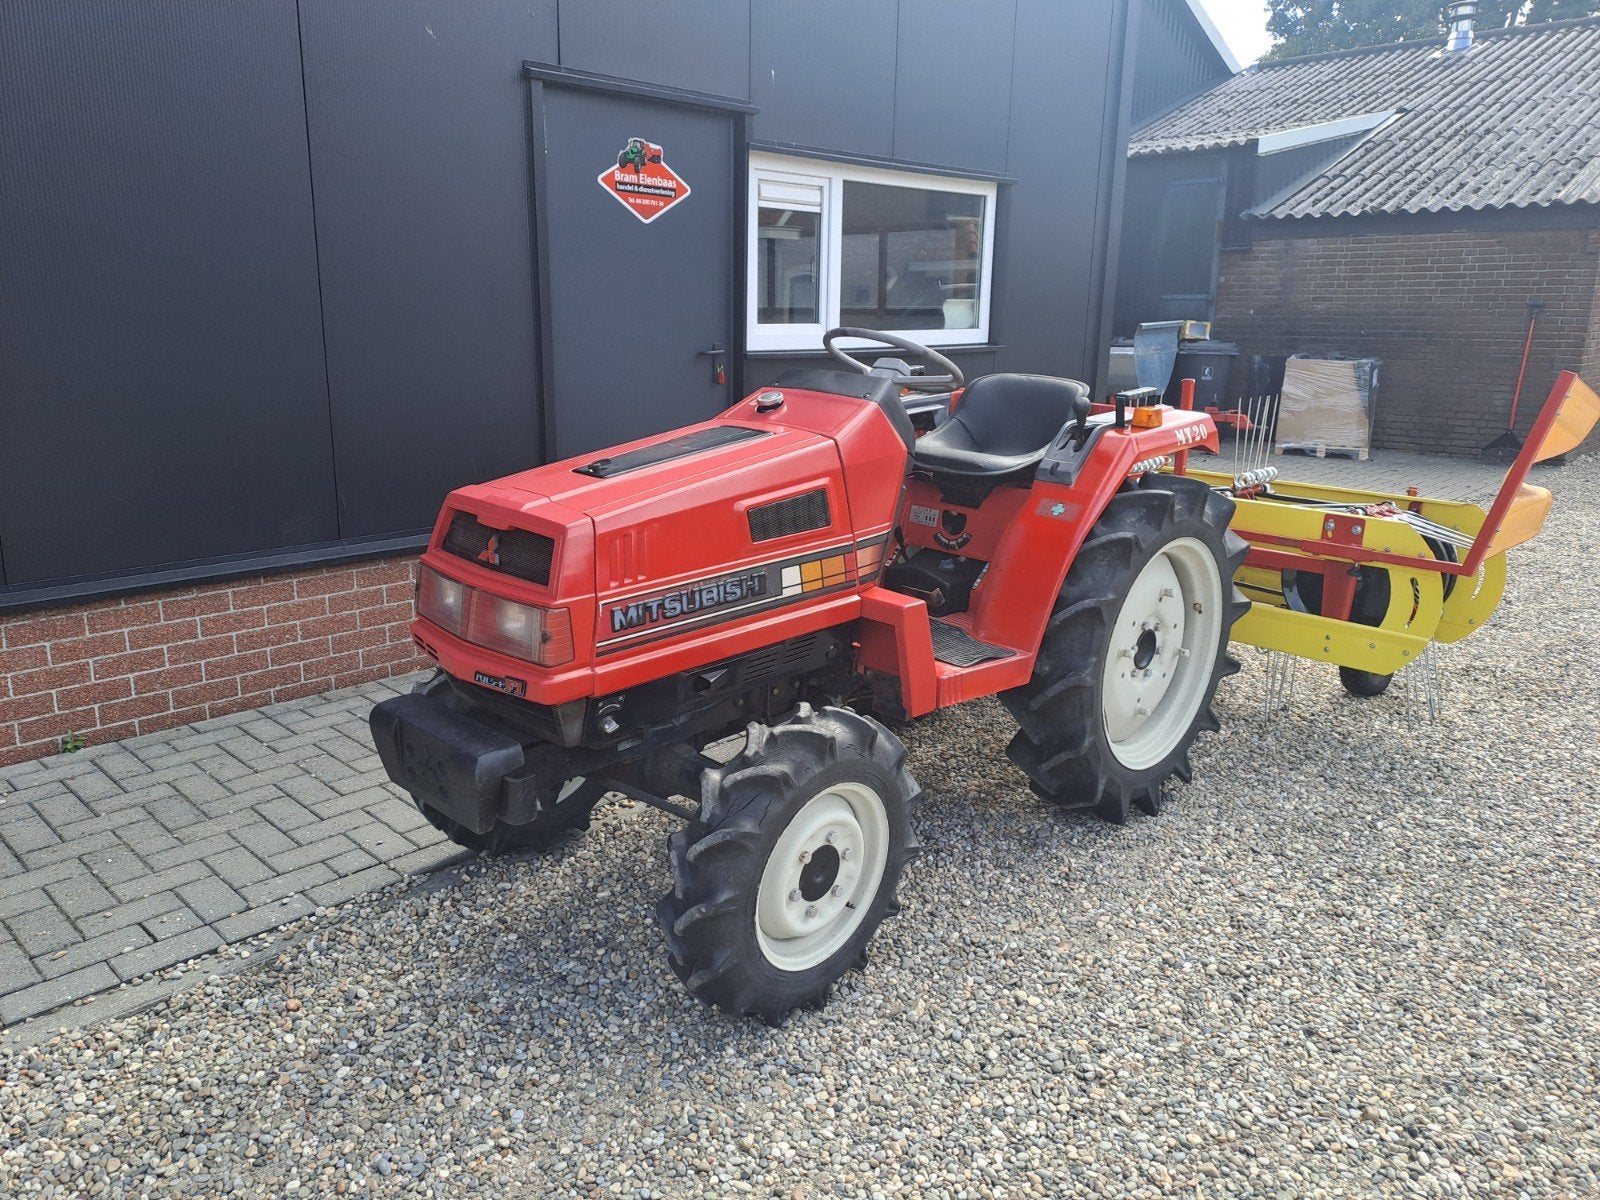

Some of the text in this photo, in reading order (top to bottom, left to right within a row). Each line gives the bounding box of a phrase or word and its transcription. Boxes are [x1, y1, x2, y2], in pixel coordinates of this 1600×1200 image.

[614, 170, 677, 188] Bram Elenbaas
[616, 183, 634, 192] handel
[639, 187, 676, 197] dienstverlening
[1174, 424, 1208, 446] MT20
